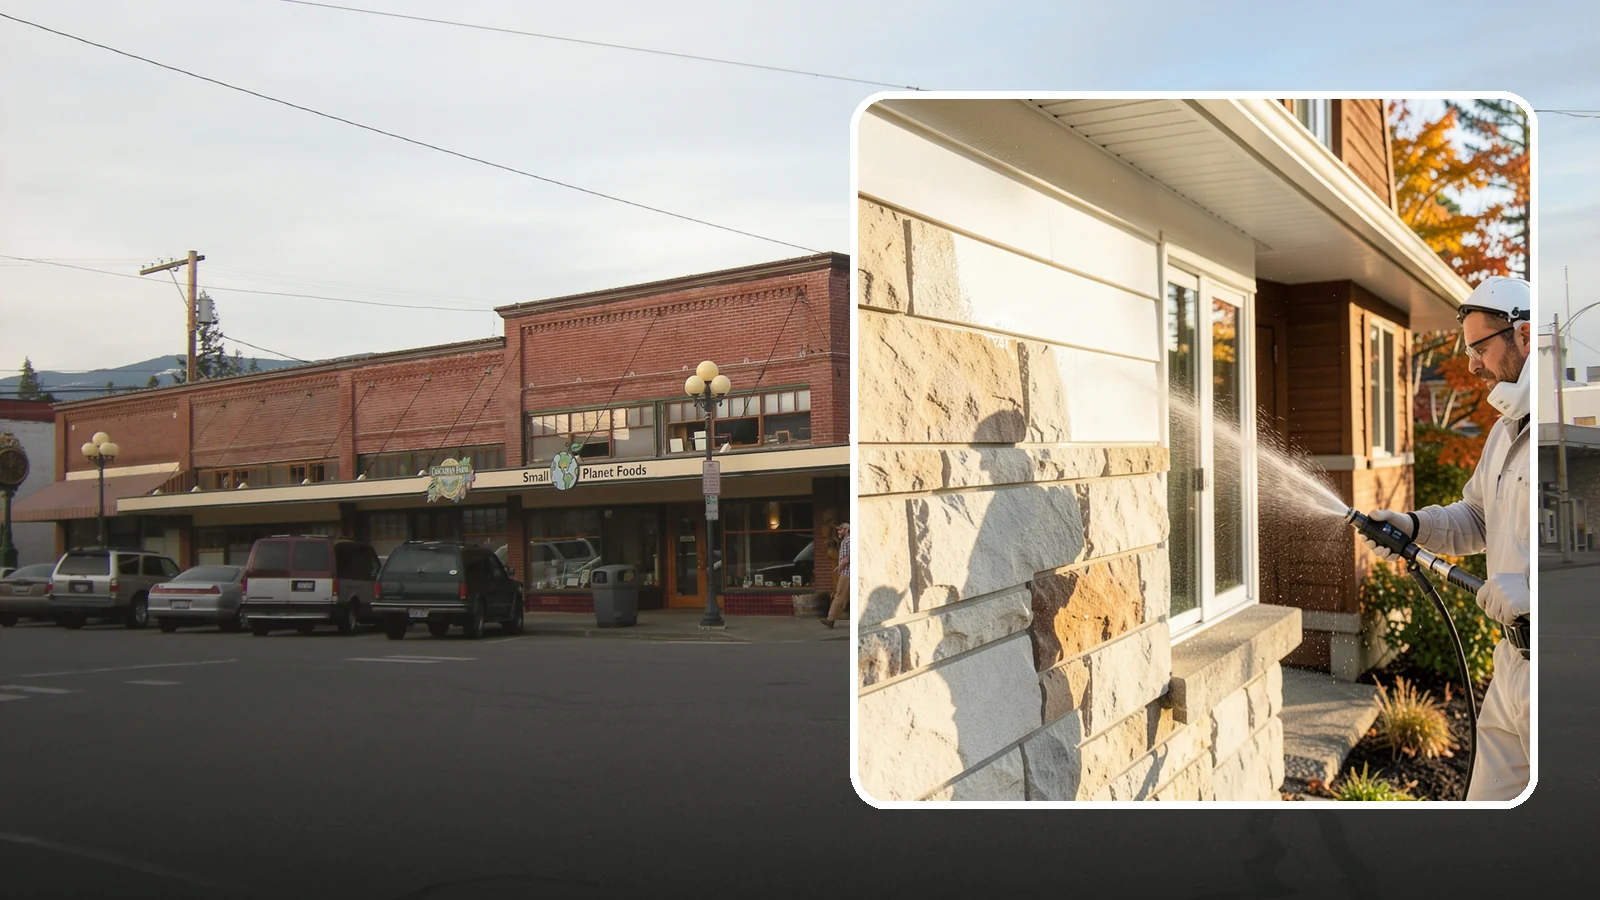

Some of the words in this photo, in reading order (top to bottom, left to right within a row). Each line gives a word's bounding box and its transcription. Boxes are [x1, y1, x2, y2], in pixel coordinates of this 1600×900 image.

[523, 471, 549, 483] Small
[583, 468, 614, 479] Planet
[617, 464, 647, 477] Foods
